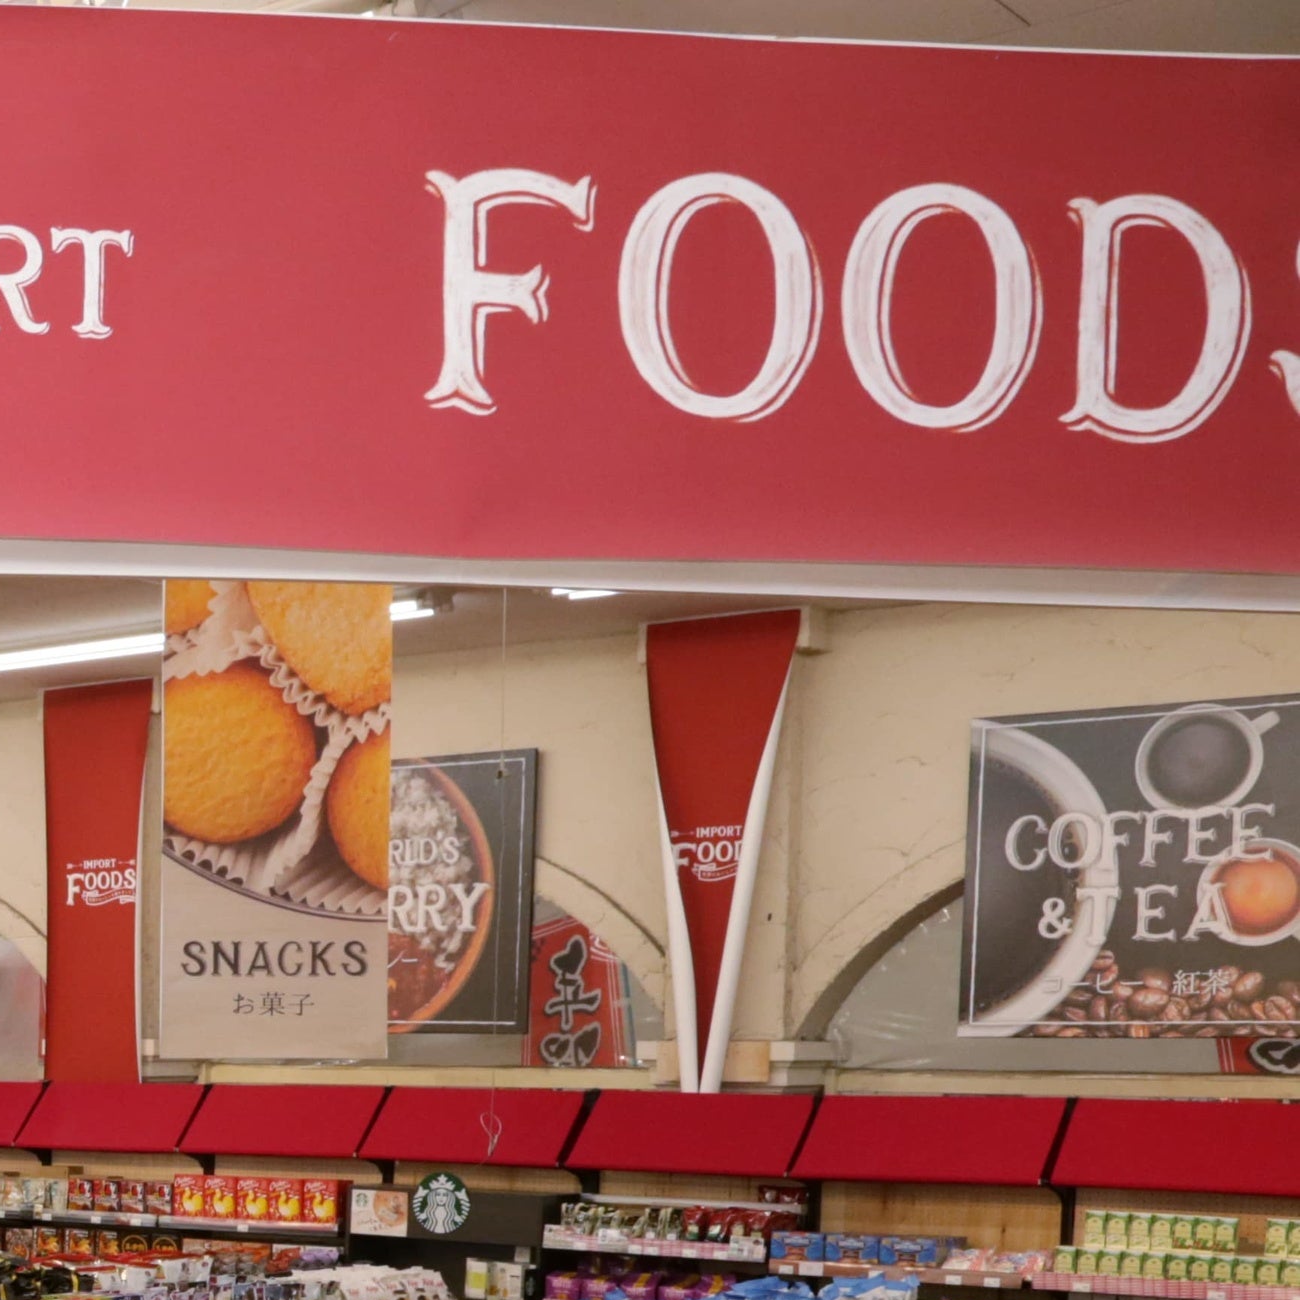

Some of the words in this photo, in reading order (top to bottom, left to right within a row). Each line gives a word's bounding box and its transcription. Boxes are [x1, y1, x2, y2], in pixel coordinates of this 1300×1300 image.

[425, 167, 1300, 445] FOOD
[695, 825, 743, 838] IMPORT
[1005, 803, 1277, 872] COFFEE
[83, 858, 116, 869] IMPORT
[66, 868, 136, 906] FOODS
[1075, 881, 1229, 945] TEA
[181, 940, 368, 977] SNACKS
[1041, 967, 1231, 998] コーヒー・紅茶
[232, 991, 315, 1017] お菓子
